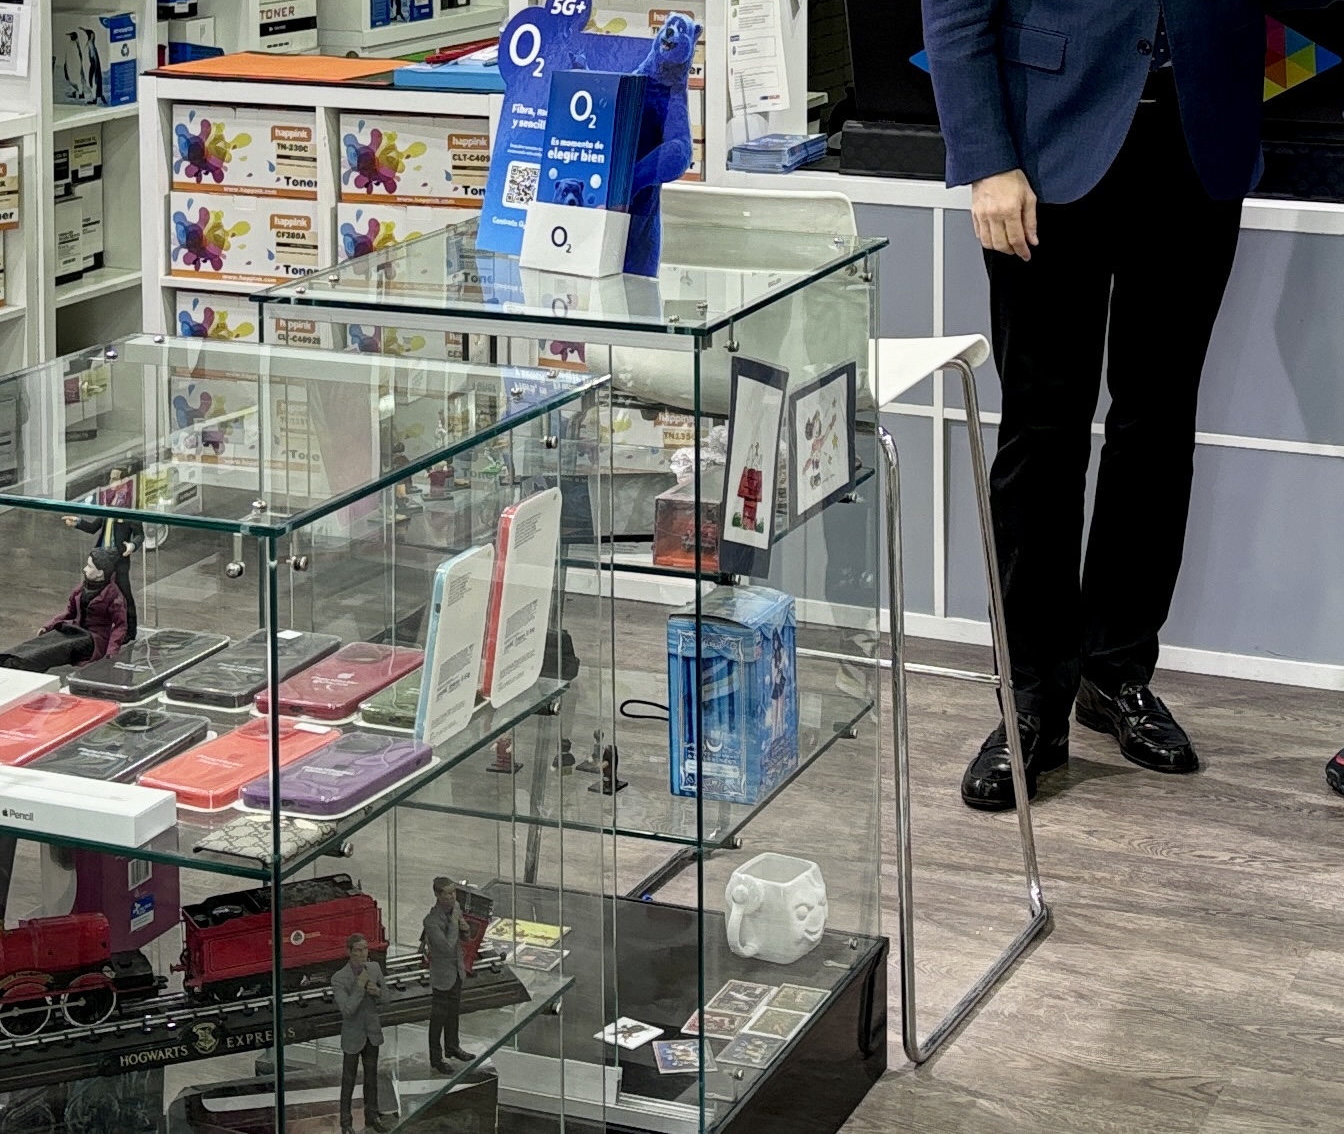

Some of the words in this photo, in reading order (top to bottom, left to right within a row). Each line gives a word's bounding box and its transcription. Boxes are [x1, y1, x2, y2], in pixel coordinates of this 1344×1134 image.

[259, 6, 295, 19] TONER
[512, 103, 535, 117] Fibra,
[275, 128, 308, 139] happink
[551, 137, 559, 146] Es
[560, 140, 594, 149] momento
[595, 141, 604, 150] de
[547, 147, 579, 164] elegir
[581, 150, 605, 164] bien
[273, 216, 308, 228] happink
[9, 809, 34, 822] Pencil
[120, 1045, 189, 1067] HOGWARTS
[226, 1027, 296, 1049] EXPRES
